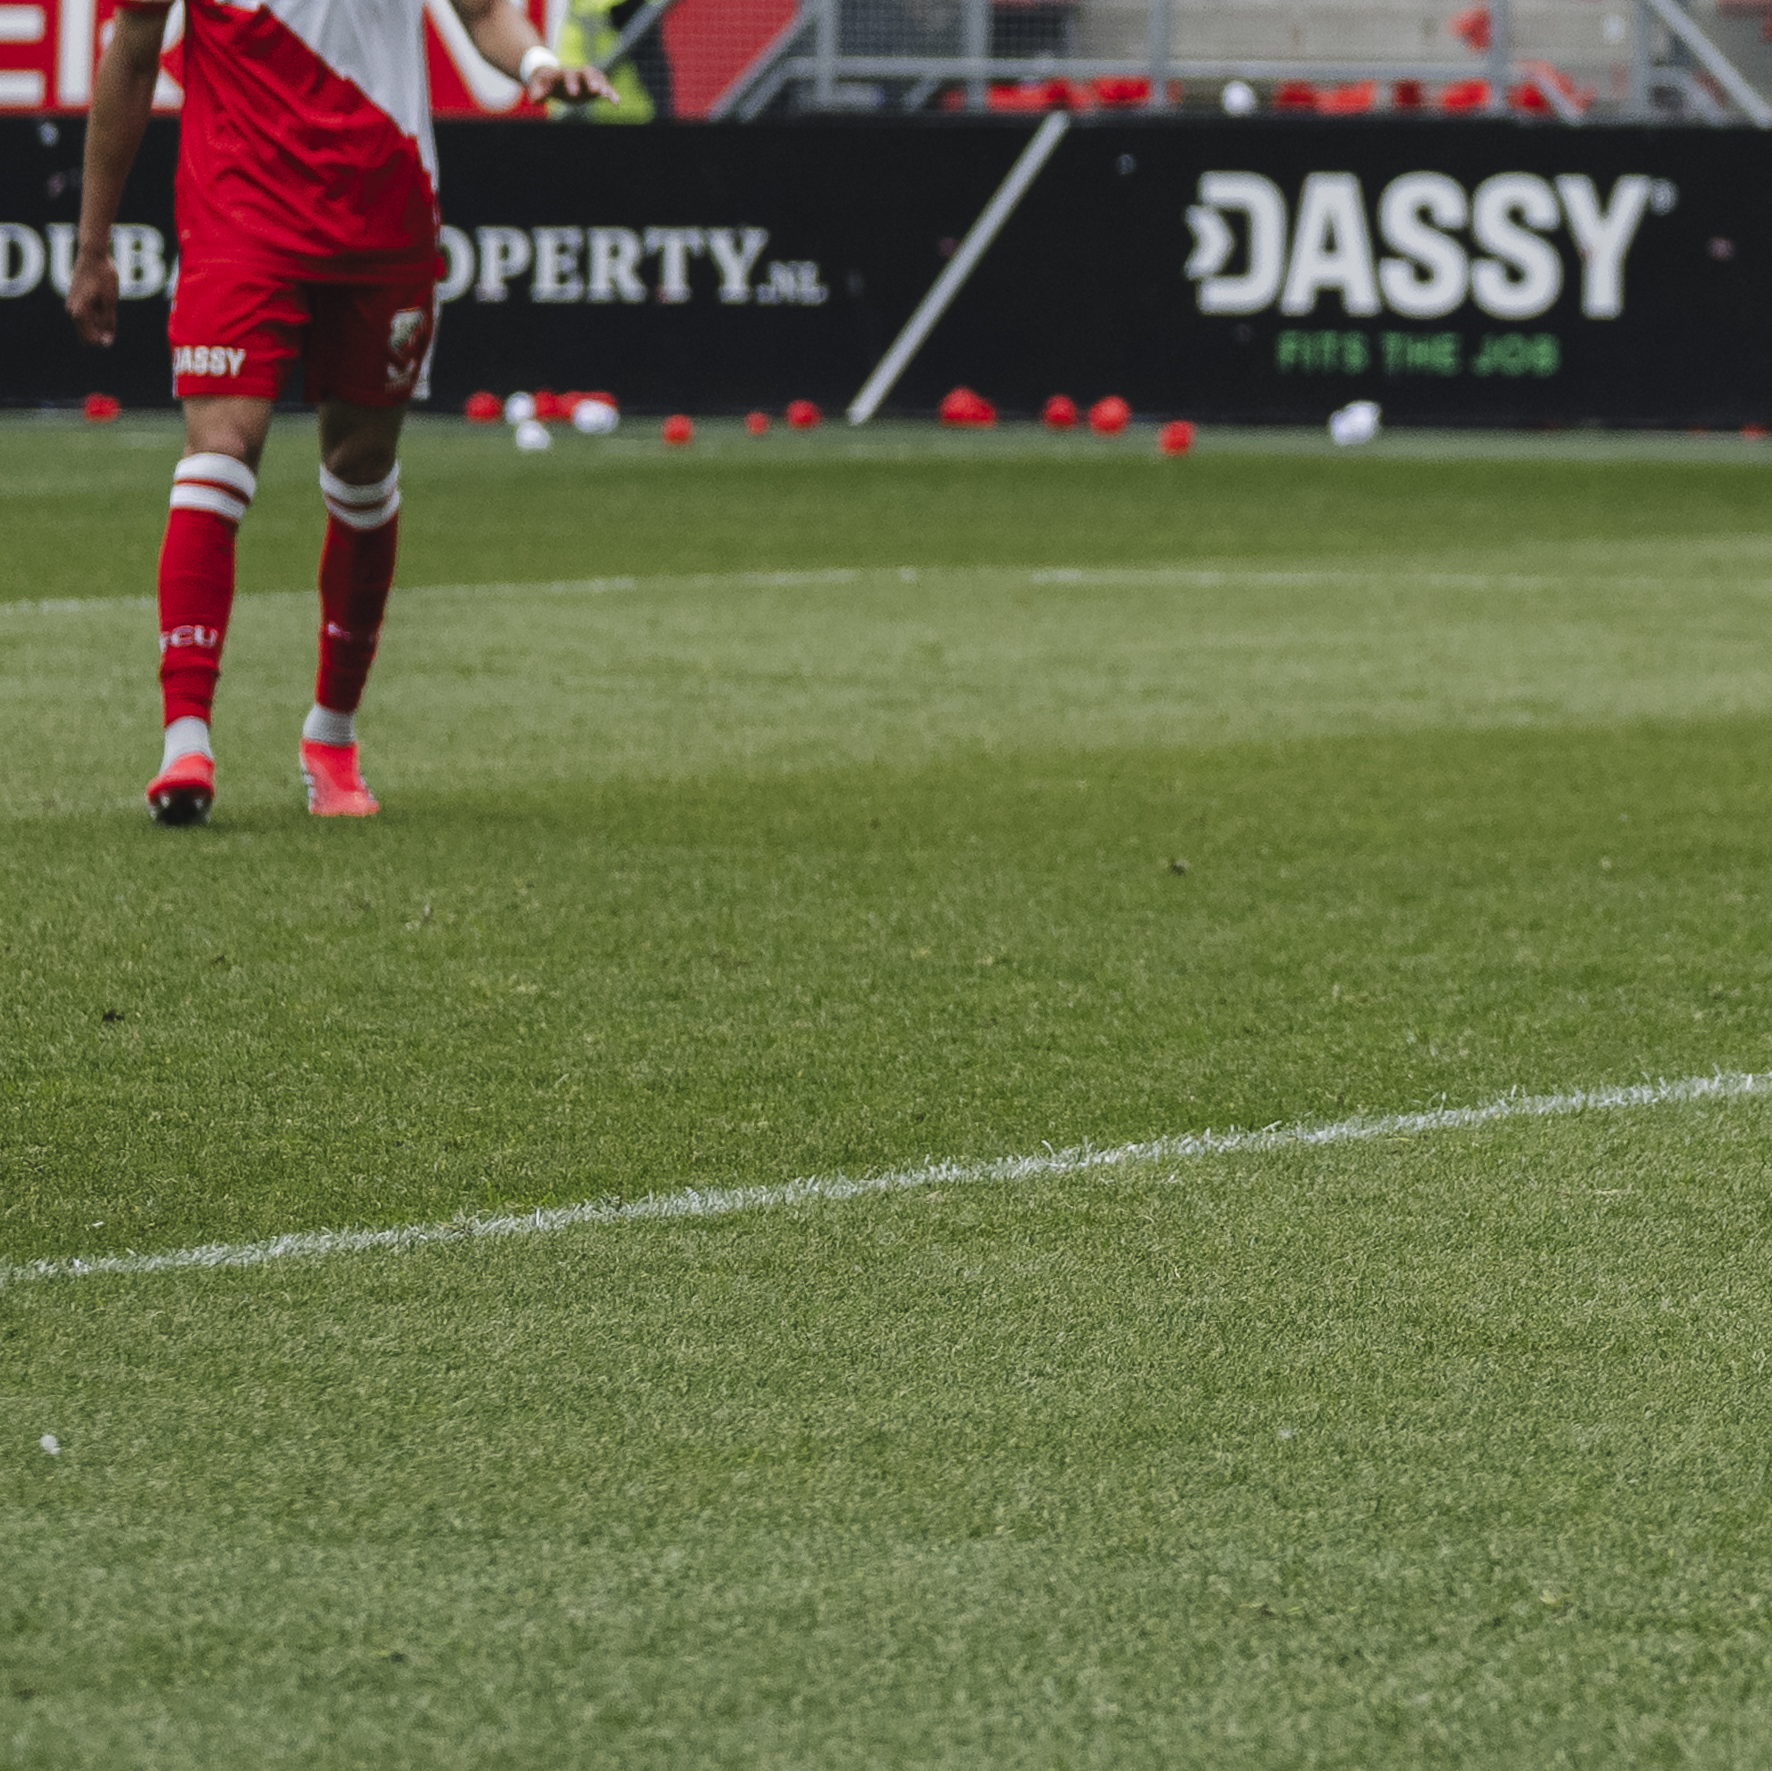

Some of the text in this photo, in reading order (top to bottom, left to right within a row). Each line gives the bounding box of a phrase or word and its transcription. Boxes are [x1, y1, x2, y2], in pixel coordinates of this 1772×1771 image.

[1276, 331, 1562, 377] FITS THE JOB
